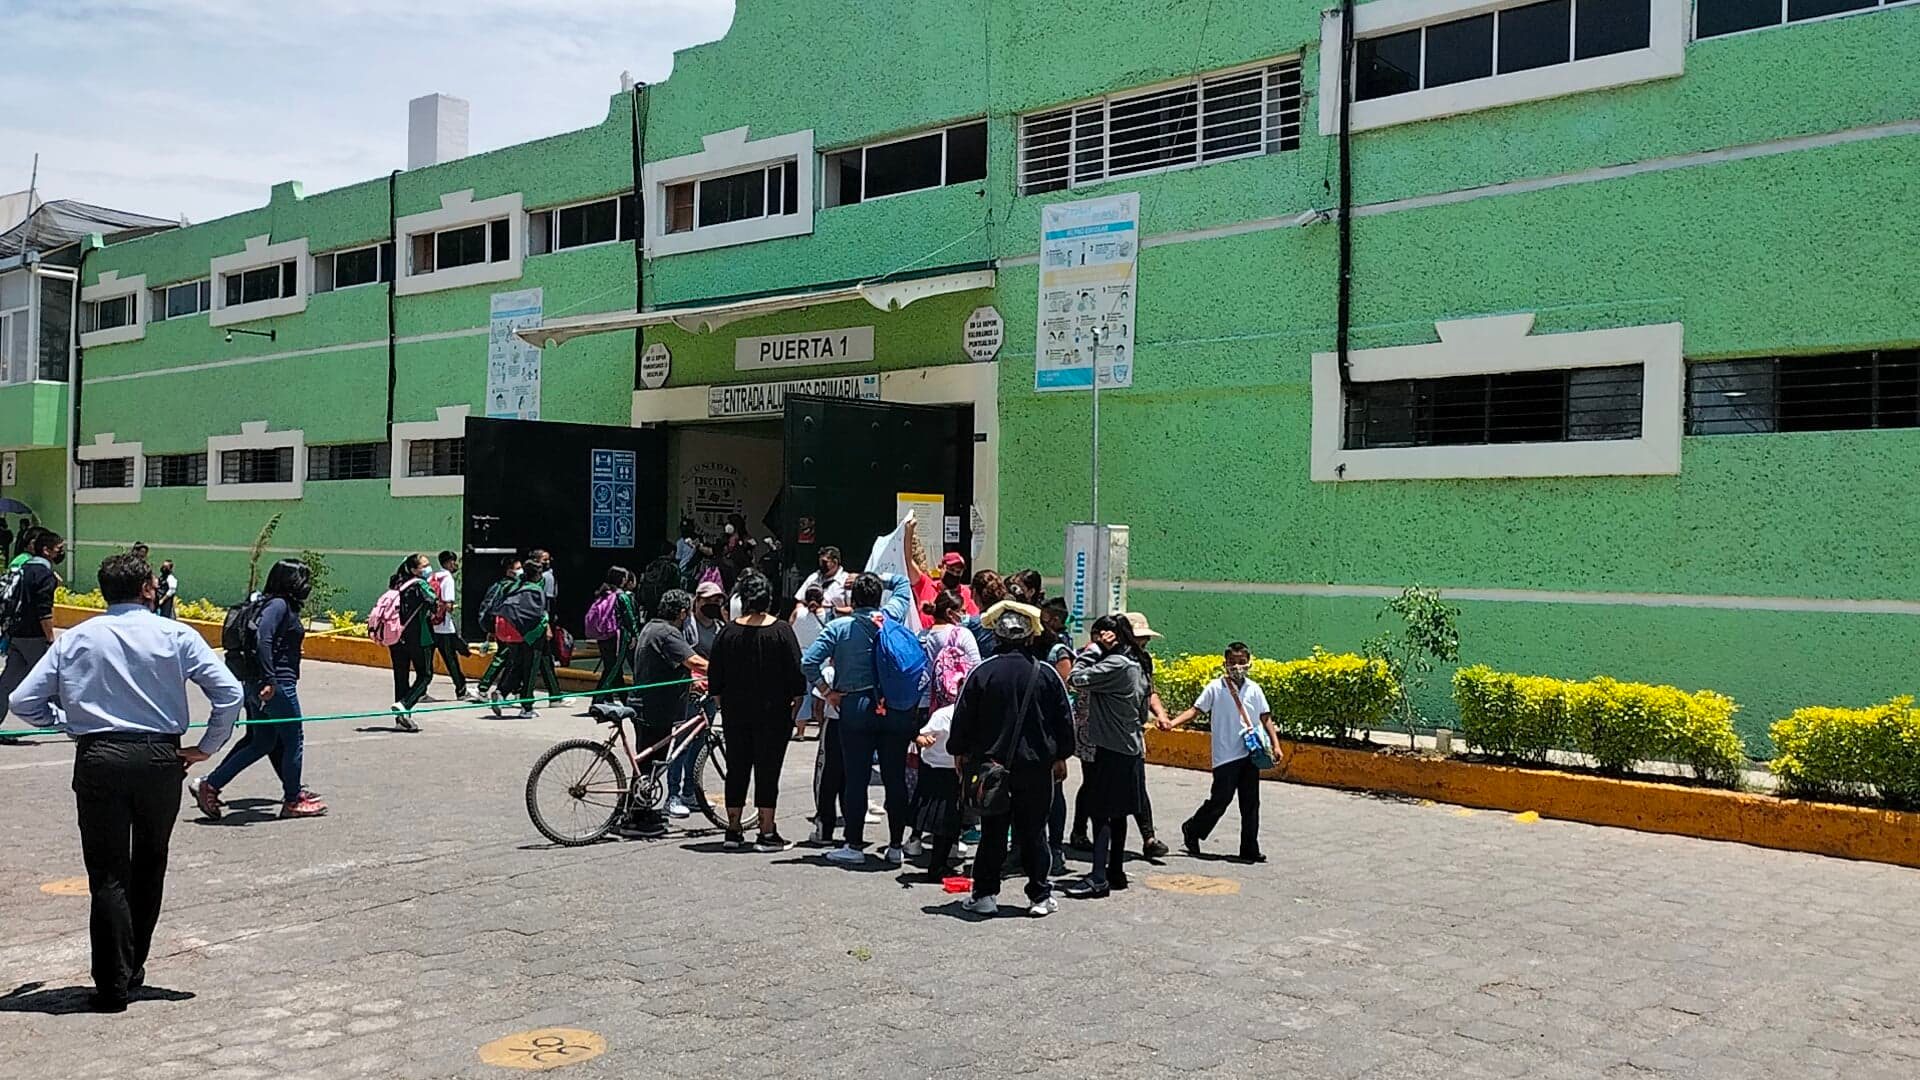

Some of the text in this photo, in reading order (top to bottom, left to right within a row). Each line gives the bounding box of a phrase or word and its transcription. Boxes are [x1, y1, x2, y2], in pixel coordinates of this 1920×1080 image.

[760, 336, 848, 361] PUERTA 1
[723, 387, 765, 413] ENTRADA
[814, 378, 861, 399] PRIMARIA
[7, 463, 12, 479] 2
[1072, 551, 1085, 633] infinitum
